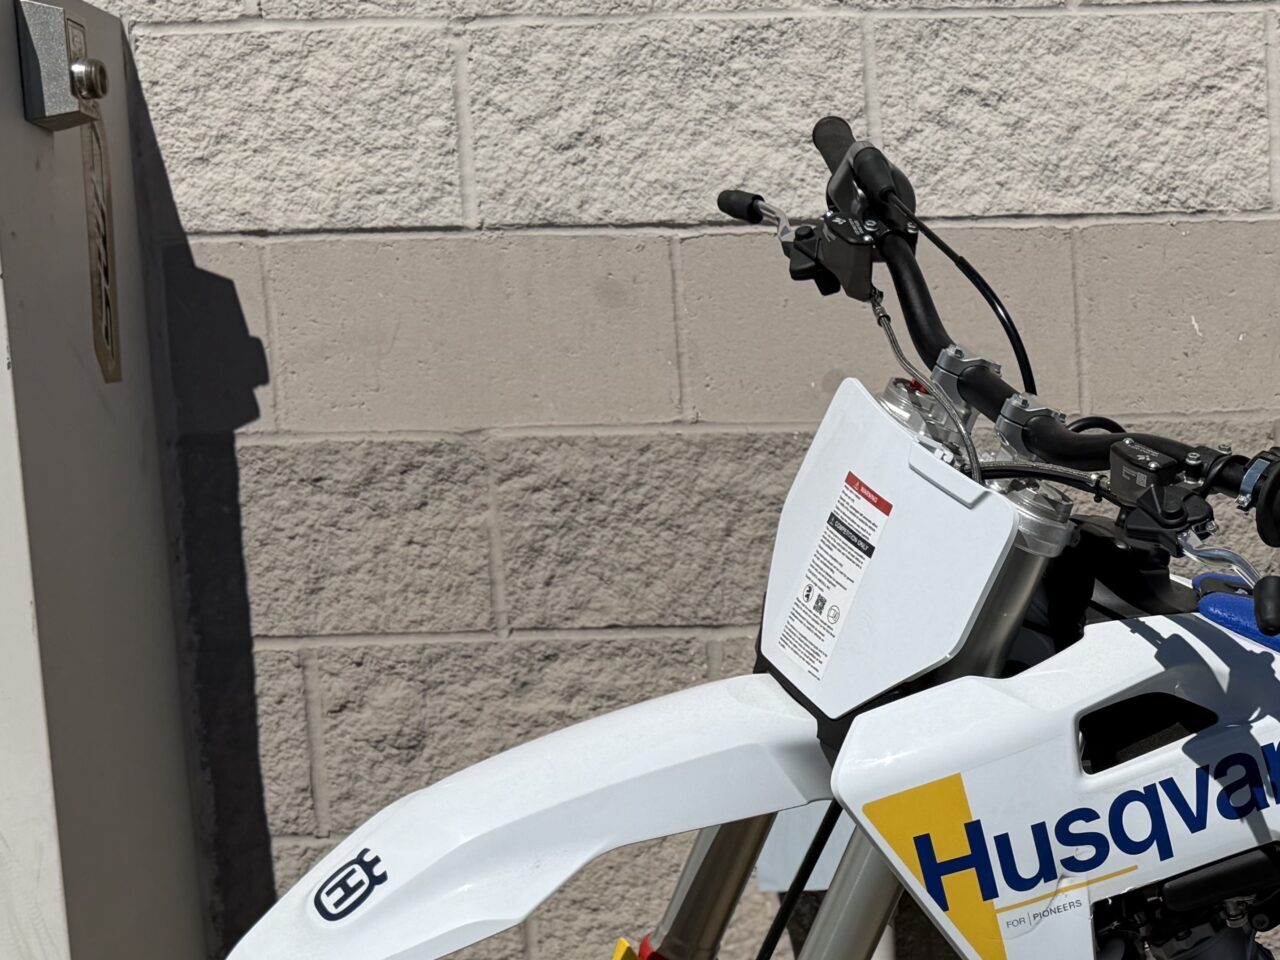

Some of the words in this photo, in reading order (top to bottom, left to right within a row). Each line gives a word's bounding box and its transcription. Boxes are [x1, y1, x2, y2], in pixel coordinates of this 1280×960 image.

[834, 520, 858, 542] COMPETITION
[857, 540, 869, 551] ONLY
[1006, 917, 1026, 928] FOR
[1032, 899, 1082, 920] PIONEERS
